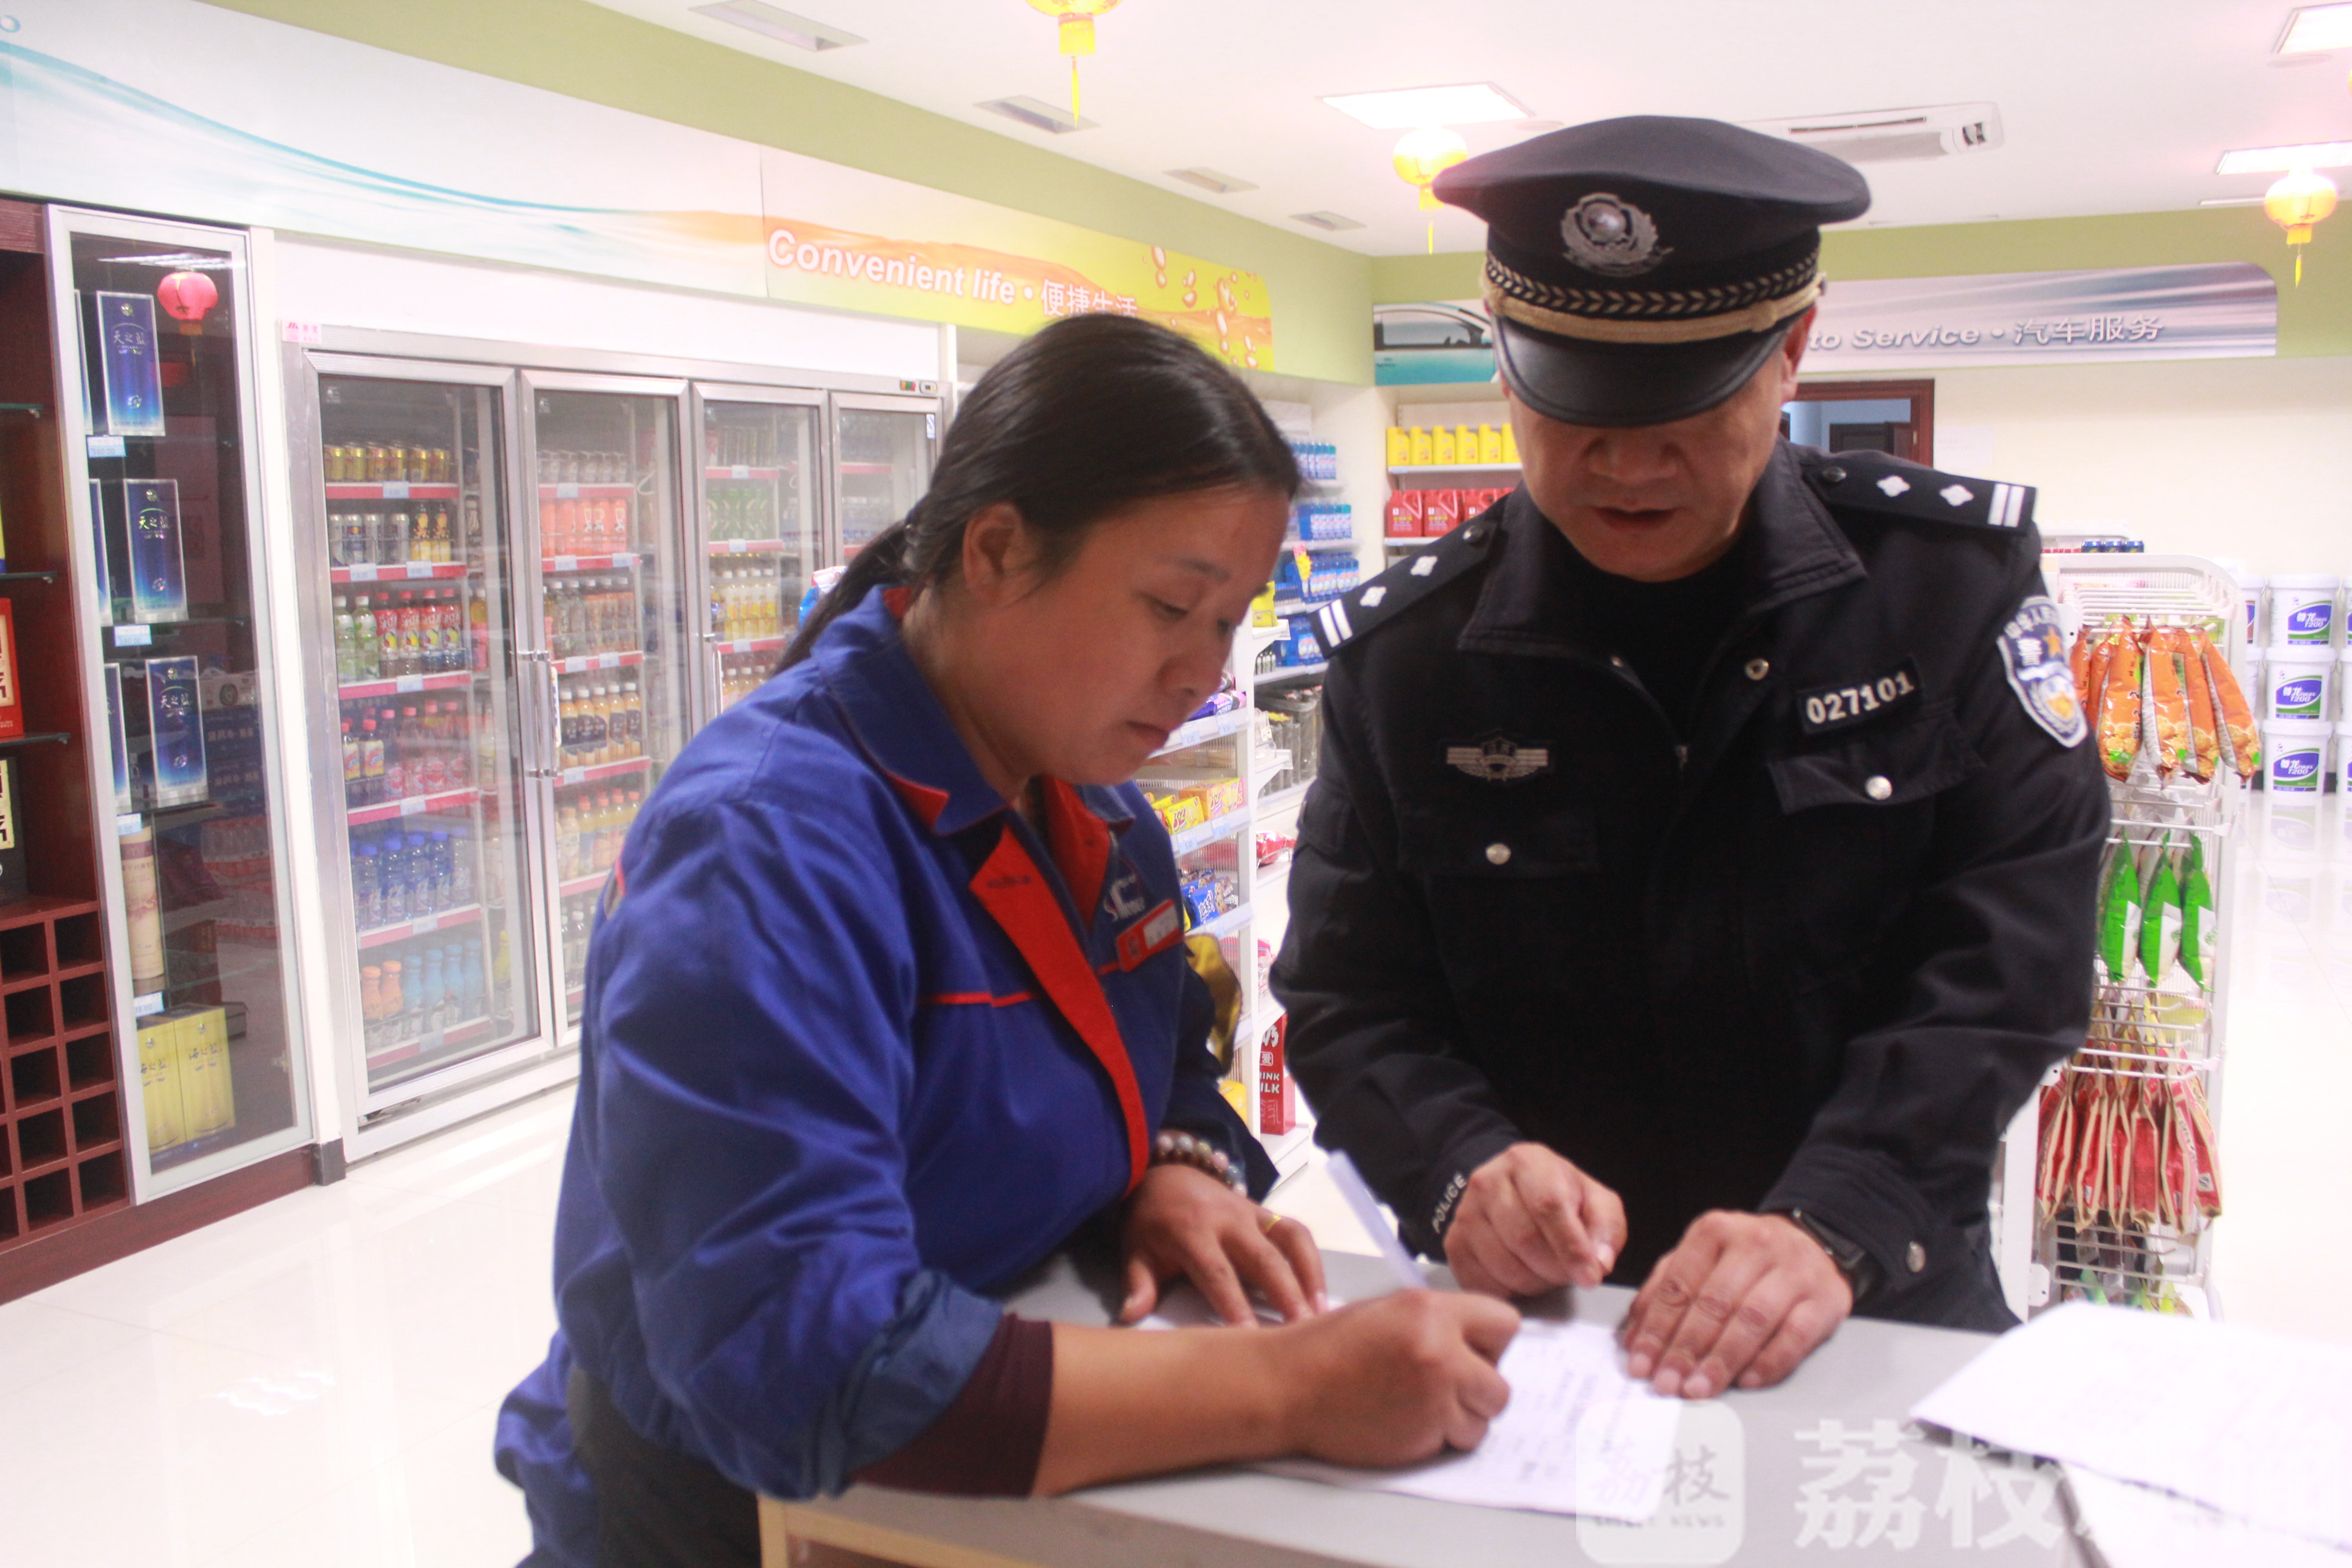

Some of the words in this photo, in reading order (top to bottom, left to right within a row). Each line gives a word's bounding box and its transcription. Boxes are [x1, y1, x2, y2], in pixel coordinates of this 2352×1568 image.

[769, 229, 965, 296] Convenient
[972, 269, 1015, 304] life
[1040, 279, 1137, 317] 便捷生活
[1852, 325, 1980, 348] Service
[2014, 314, 2164, 344] 汽车服务
[1806, 670, 1915, 724] 027101
[1431, 1171, 1467, 1234] POLICE
